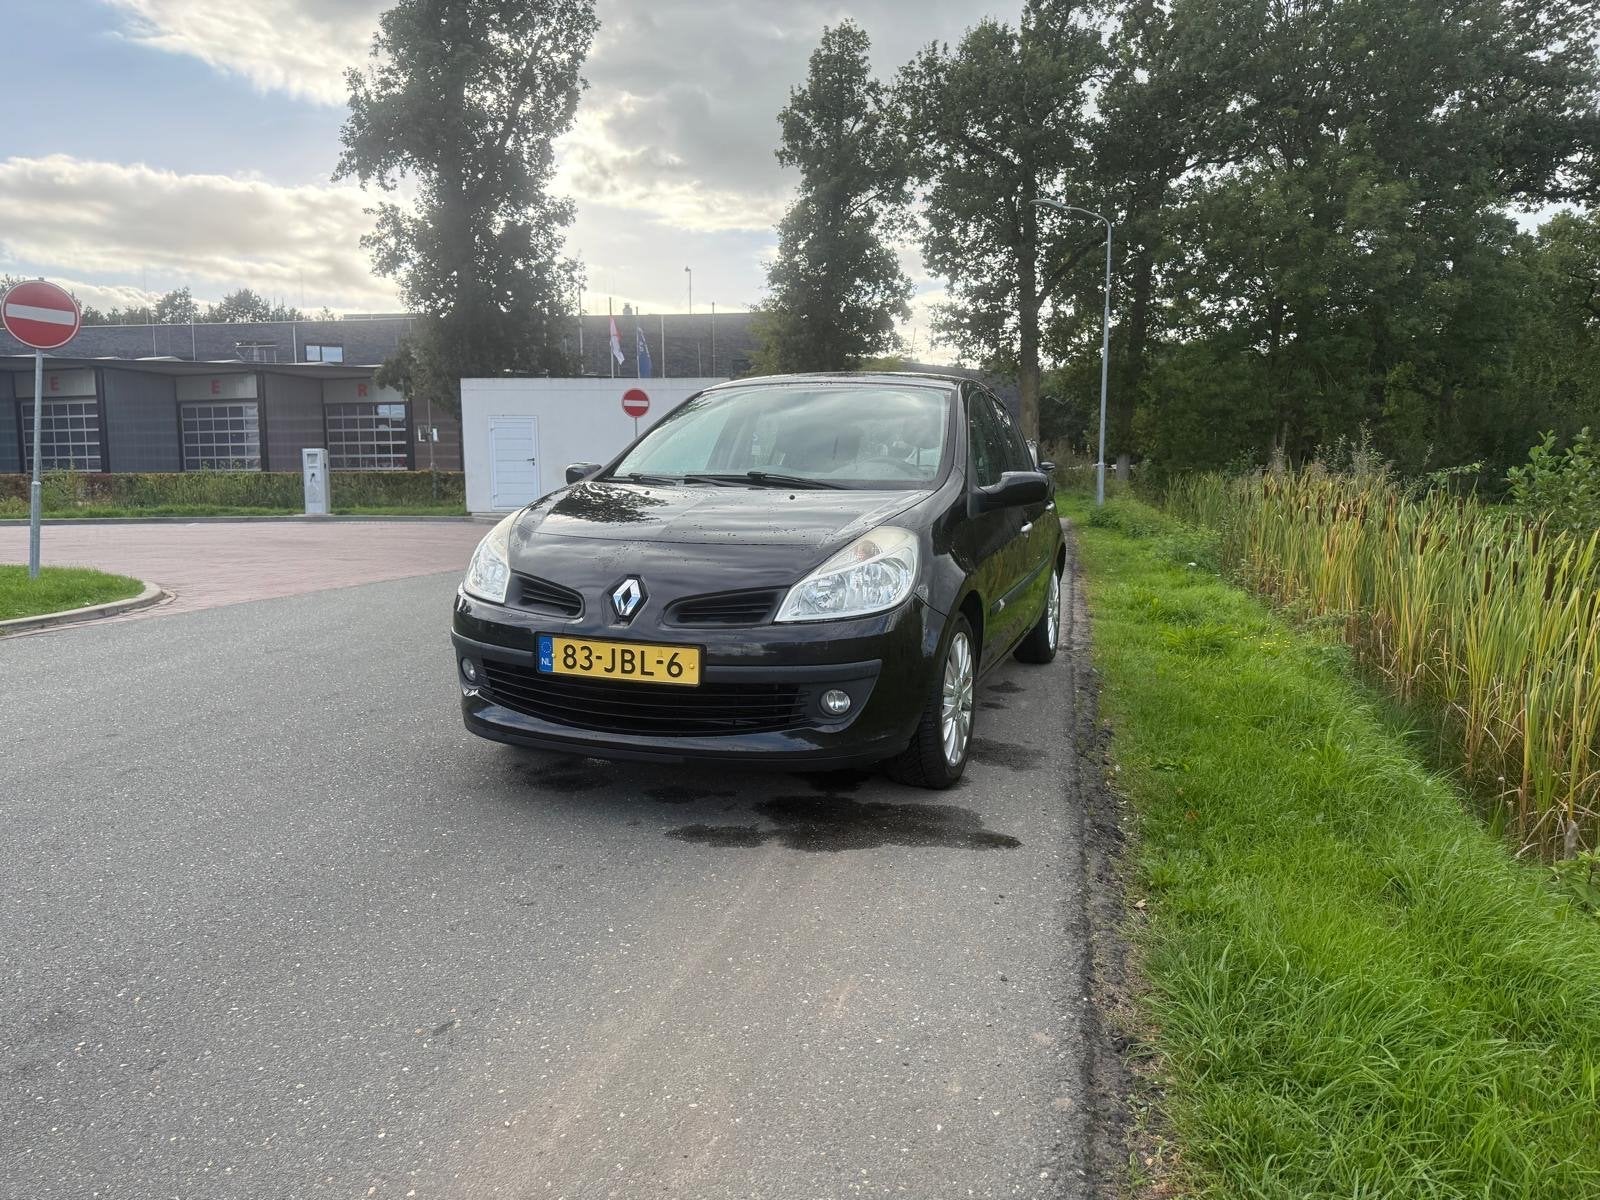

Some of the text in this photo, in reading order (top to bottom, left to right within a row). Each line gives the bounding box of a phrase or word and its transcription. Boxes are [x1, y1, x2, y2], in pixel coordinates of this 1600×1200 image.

[50, 377, 60, 391] E
[211, 380, 221, 394] E
[357, 383, 368, 397] R
[541, 657, 552, 666] NL
[562, 644, 684, 678] 83-JBL-6
